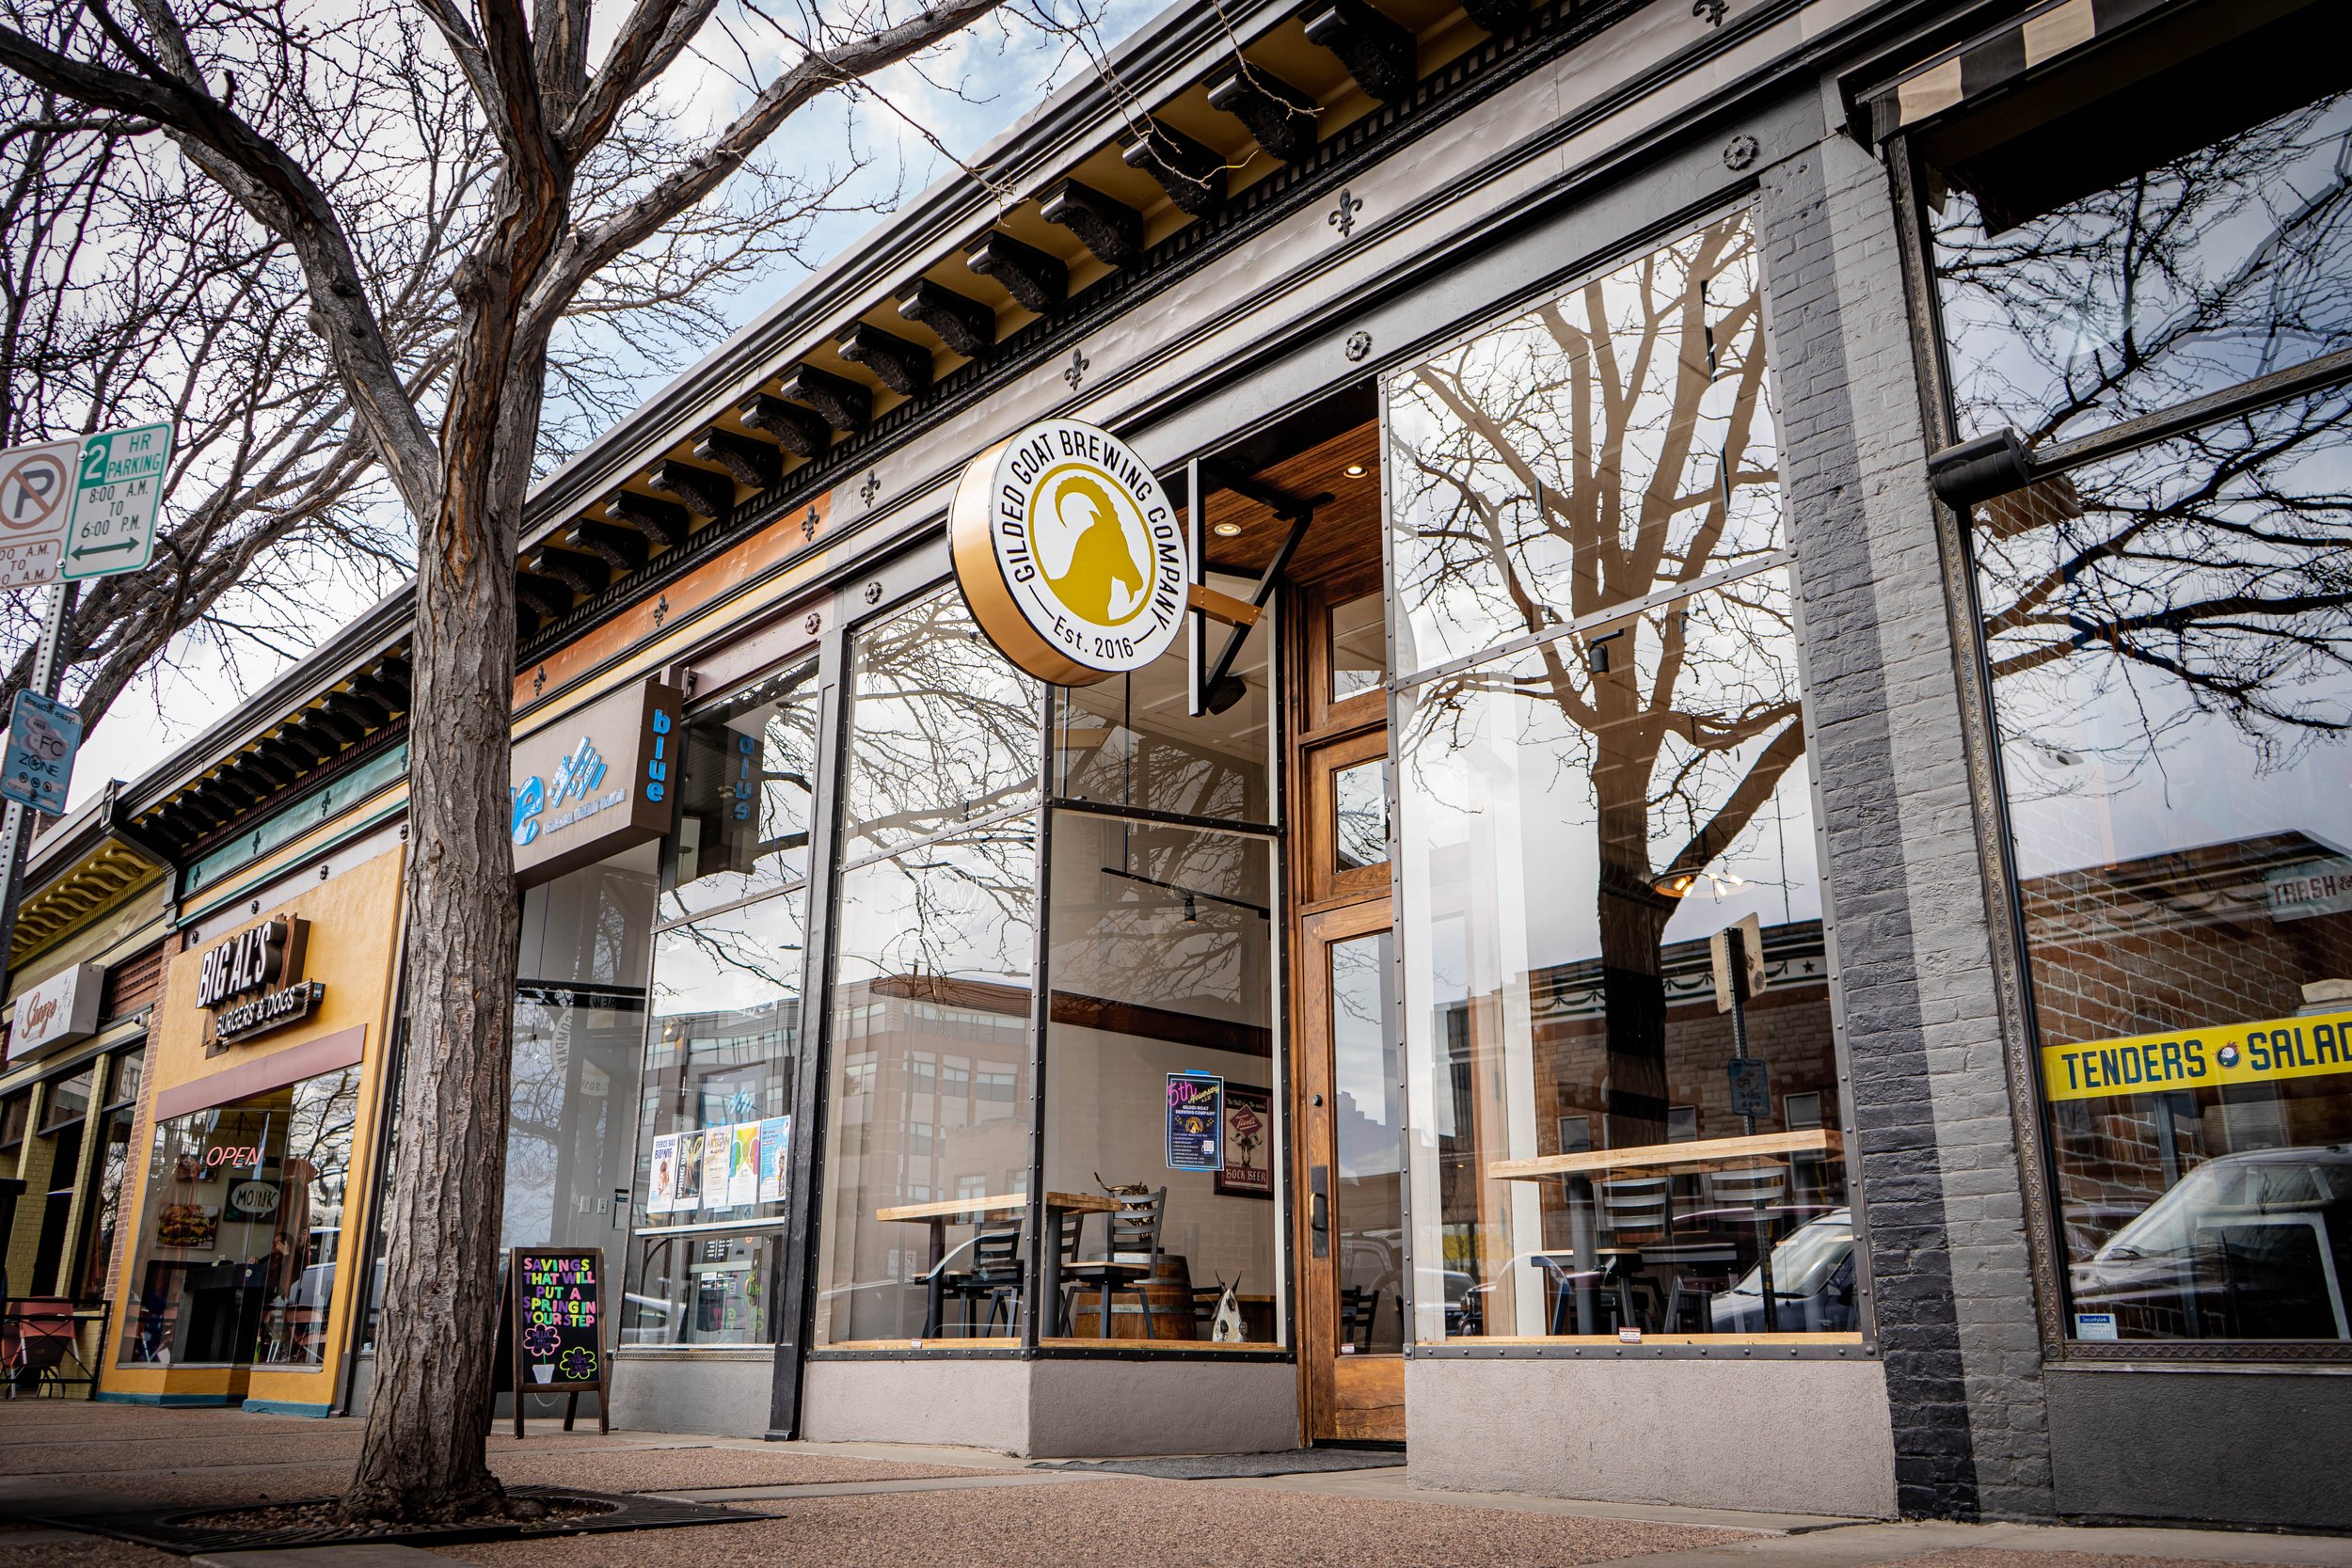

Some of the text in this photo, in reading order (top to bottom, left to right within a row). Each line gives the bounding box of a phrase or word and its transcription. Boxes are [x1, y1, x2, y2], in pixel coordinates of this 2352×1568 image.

[84, 434, 151, 481] 2 HR
[106, 453, 161, 479] PARKING
[89, 480, 149, 503] 8:00 A.M.
[109, 500, 123, 517] TO
[81, 515, 141, 538] 6:00 P.M.
[1001, 430, 1180, 631] GILDED GOAT BREWING COMPANY
[25, 544, 50, 557] A.M.
[10, 559, 26, 571] TO
[23, 568, 47, 581] A.M.
[1054, 615, 1134, 659] Est. 2016
[40, 736, 64, 757] FC
[646, 709, 671, 802] blue
[2270, 875, 2338, 906] TRASH
[196, 921, 272, 1009] BIG AL'S
[216, 987, 295, 1037] BURGERS & DOGS
[2061, 1021, 2352, 1090] TENDERS SALAD
[1168, 1081, 1197, 1106] 5th
[206, 1146, 264, 1166] OPEN
[677, 1166, 686, 1199] SPRING
[1226, 1168, 1266, 1182] BOCK BEER
[236, 1189, 276, 1209] MOINK
[523, 1258, 590, 1272] SAVINGS
[523, 1271, 596, 1285] THAT WILL
[536, 1286, 581, 1300] PUT A
[523, 1296, 596, 1314] SPRING IN
[523, 1311, 595, 1327] YOUR STEP
